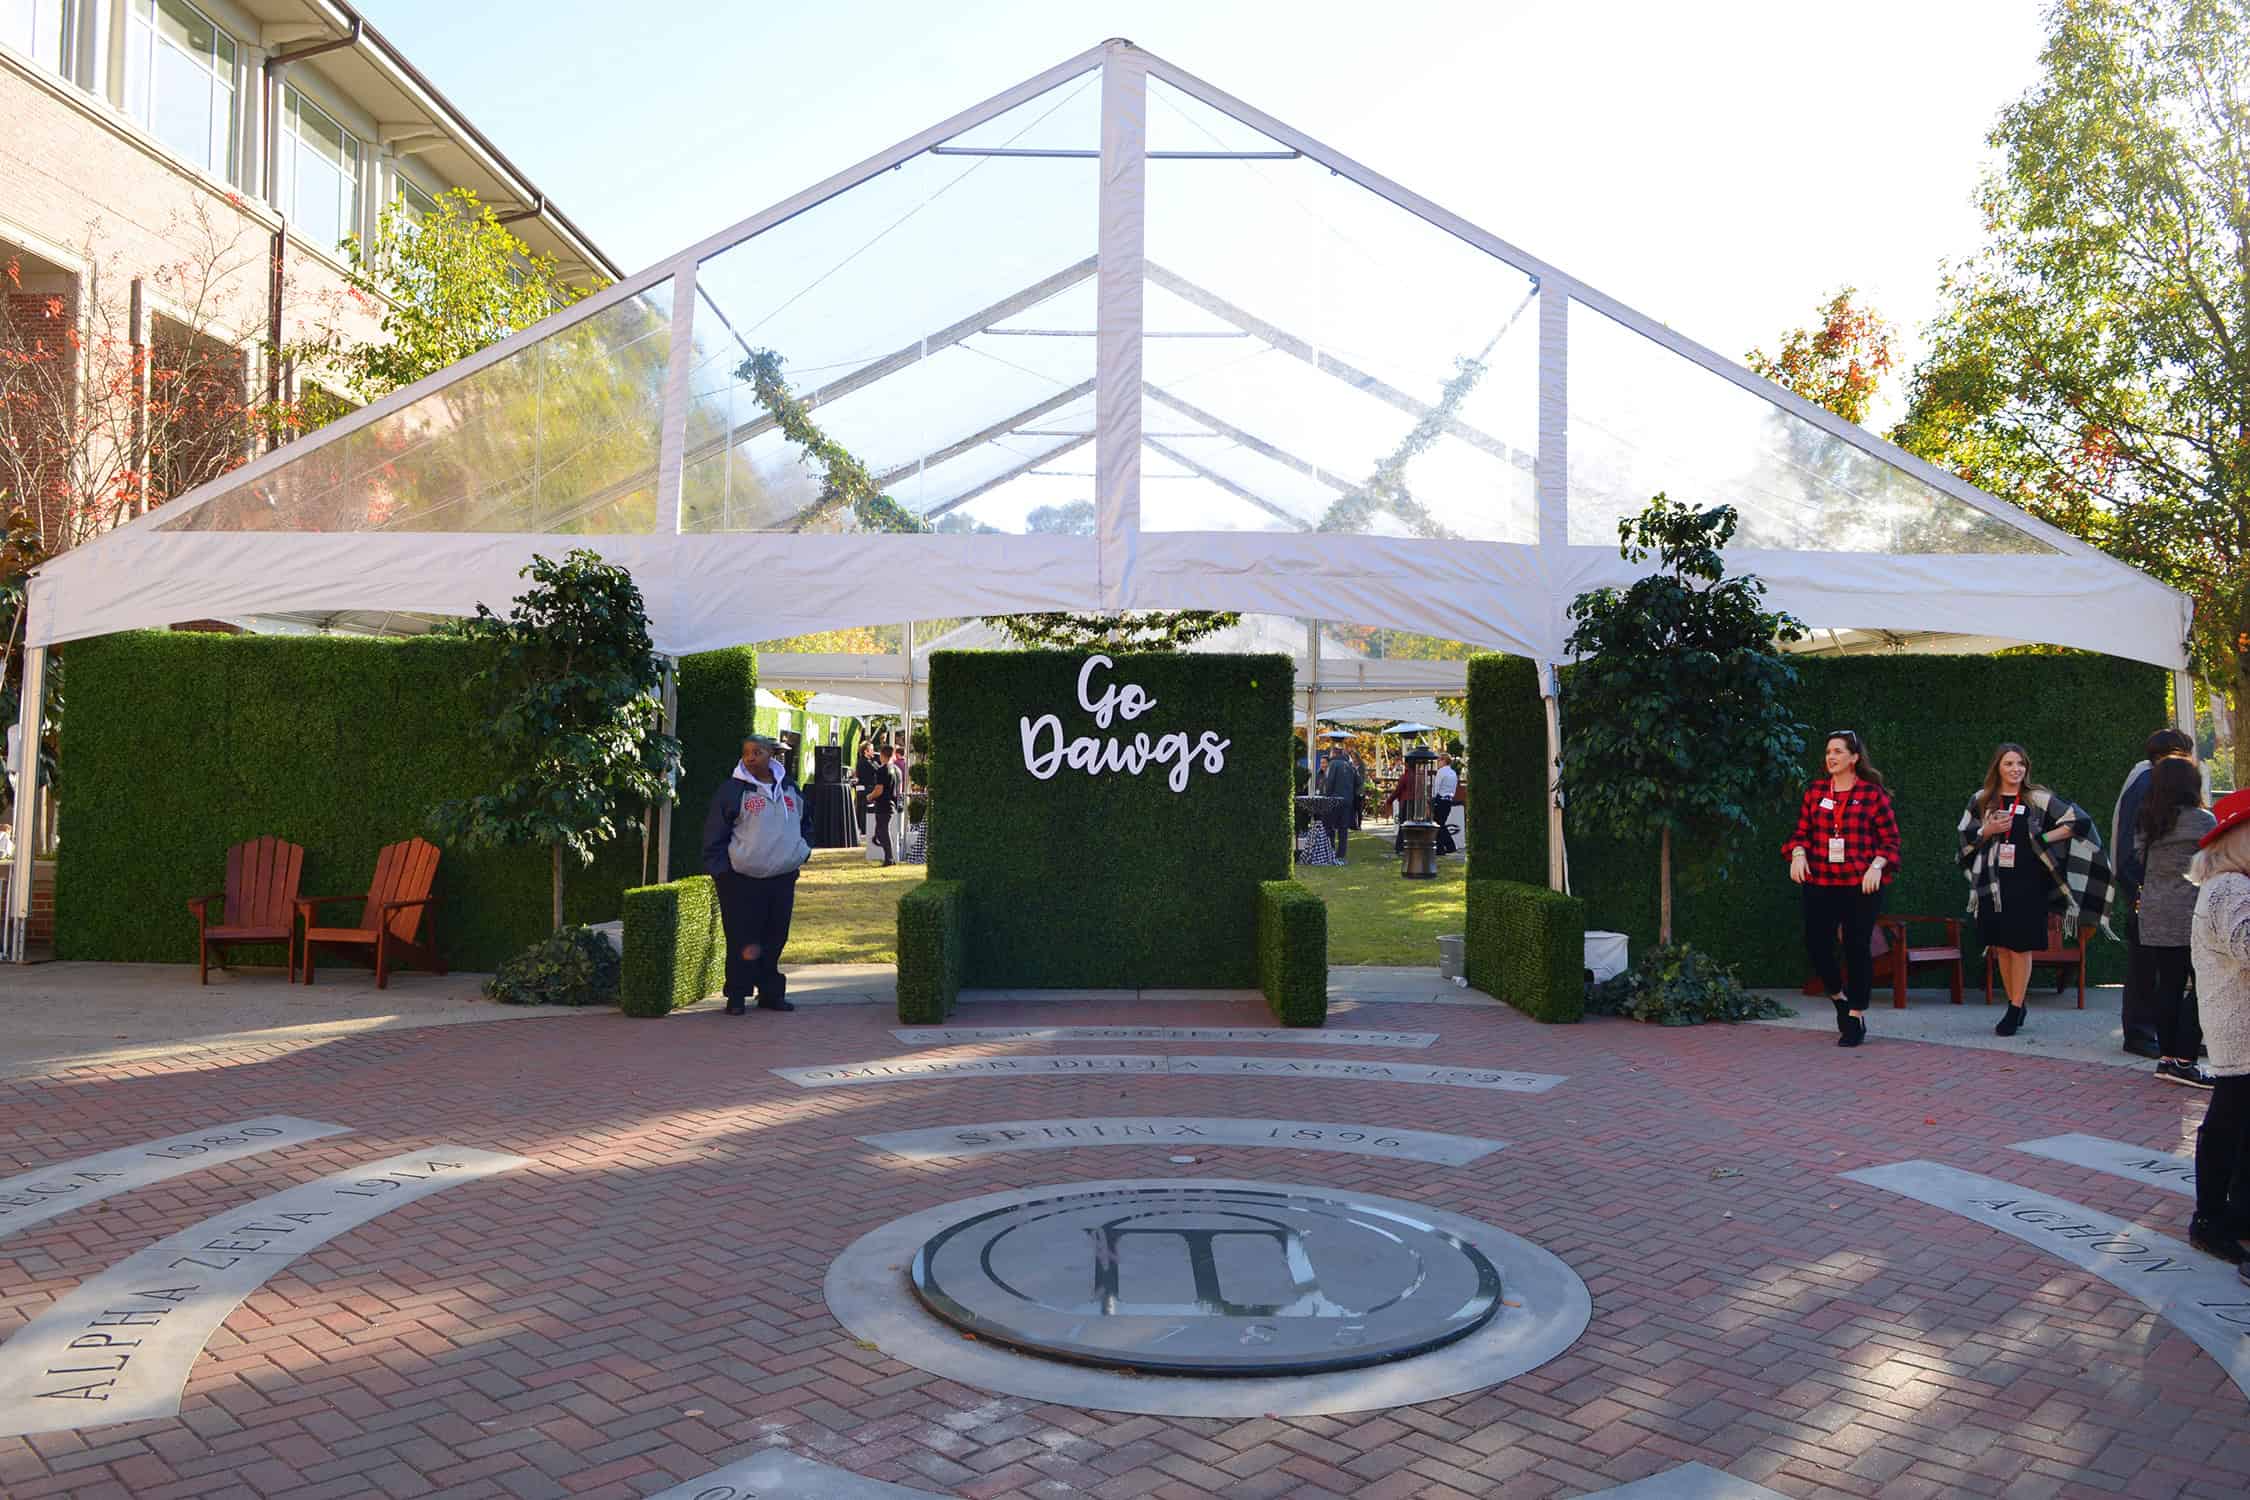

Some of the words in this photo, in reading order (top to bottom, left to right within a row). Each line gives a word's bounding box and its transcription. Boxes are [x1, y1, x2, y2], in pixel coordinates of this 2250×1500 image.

[1077, 654, 1157, 729] Go
[1020, 714, 1231, 792] Dawgs
[804, 1062, 1018, 1080] OMICRON
[145, 1126, 284, 1160] 1980
[953, 1124, 1208, 1146] SPHINX
[1967, 1198, 2200, 1274] AGHON
[33, 1282, 200, 1403] ALPHA
[167, 1206, 334, 1271] ZETA
[333, 1158, 467, 1199] 1914
